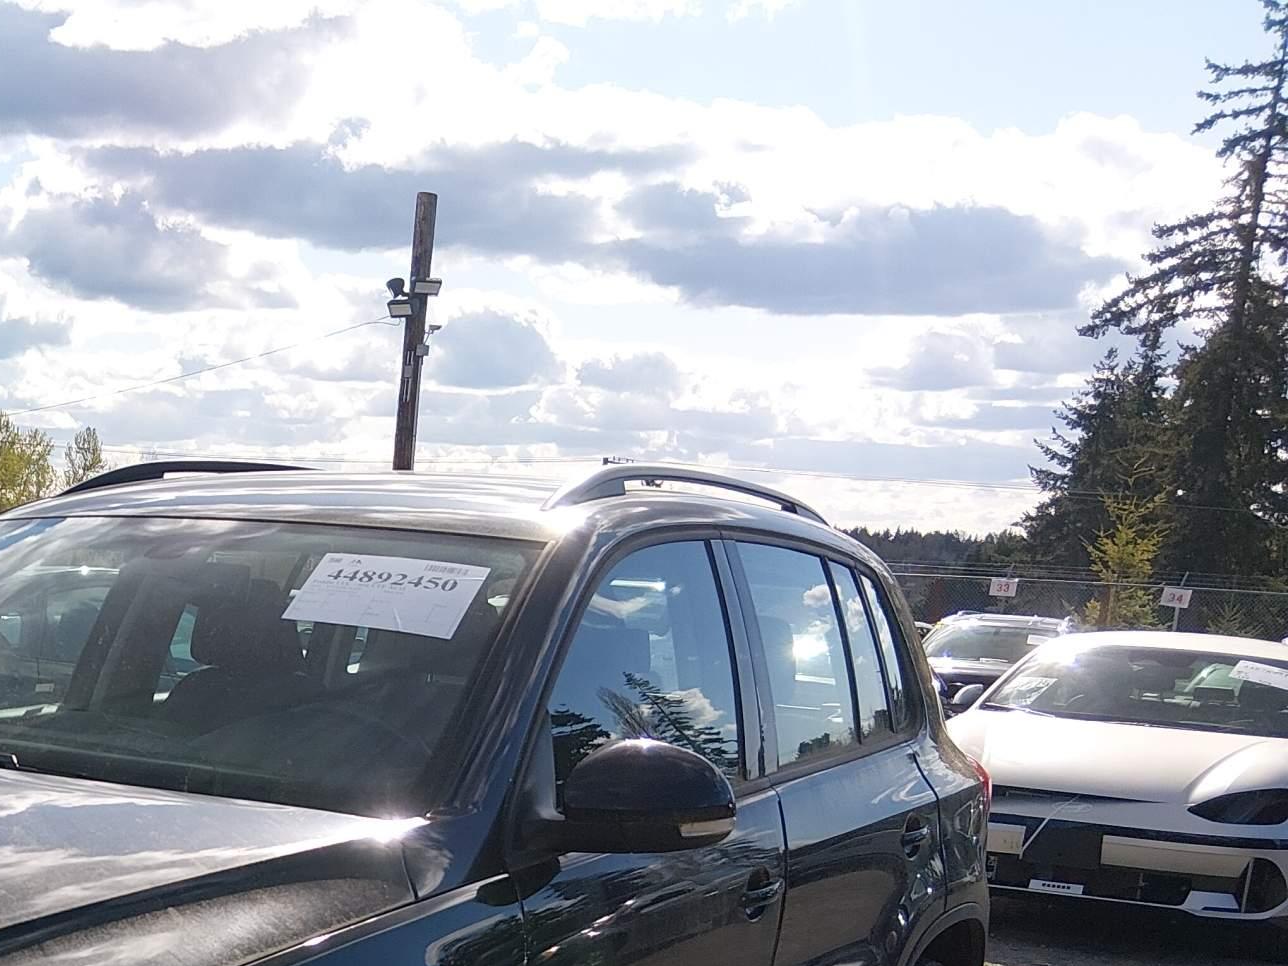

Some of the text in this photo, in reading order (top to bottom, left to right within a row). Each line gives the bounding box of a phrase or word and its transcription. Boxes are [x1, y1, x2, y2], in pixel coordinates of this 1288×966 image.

[327, 568, 458, 592] 44892450
[996, 583, 1010, 592] 33
[1167, 592, 1184, 604] 34
